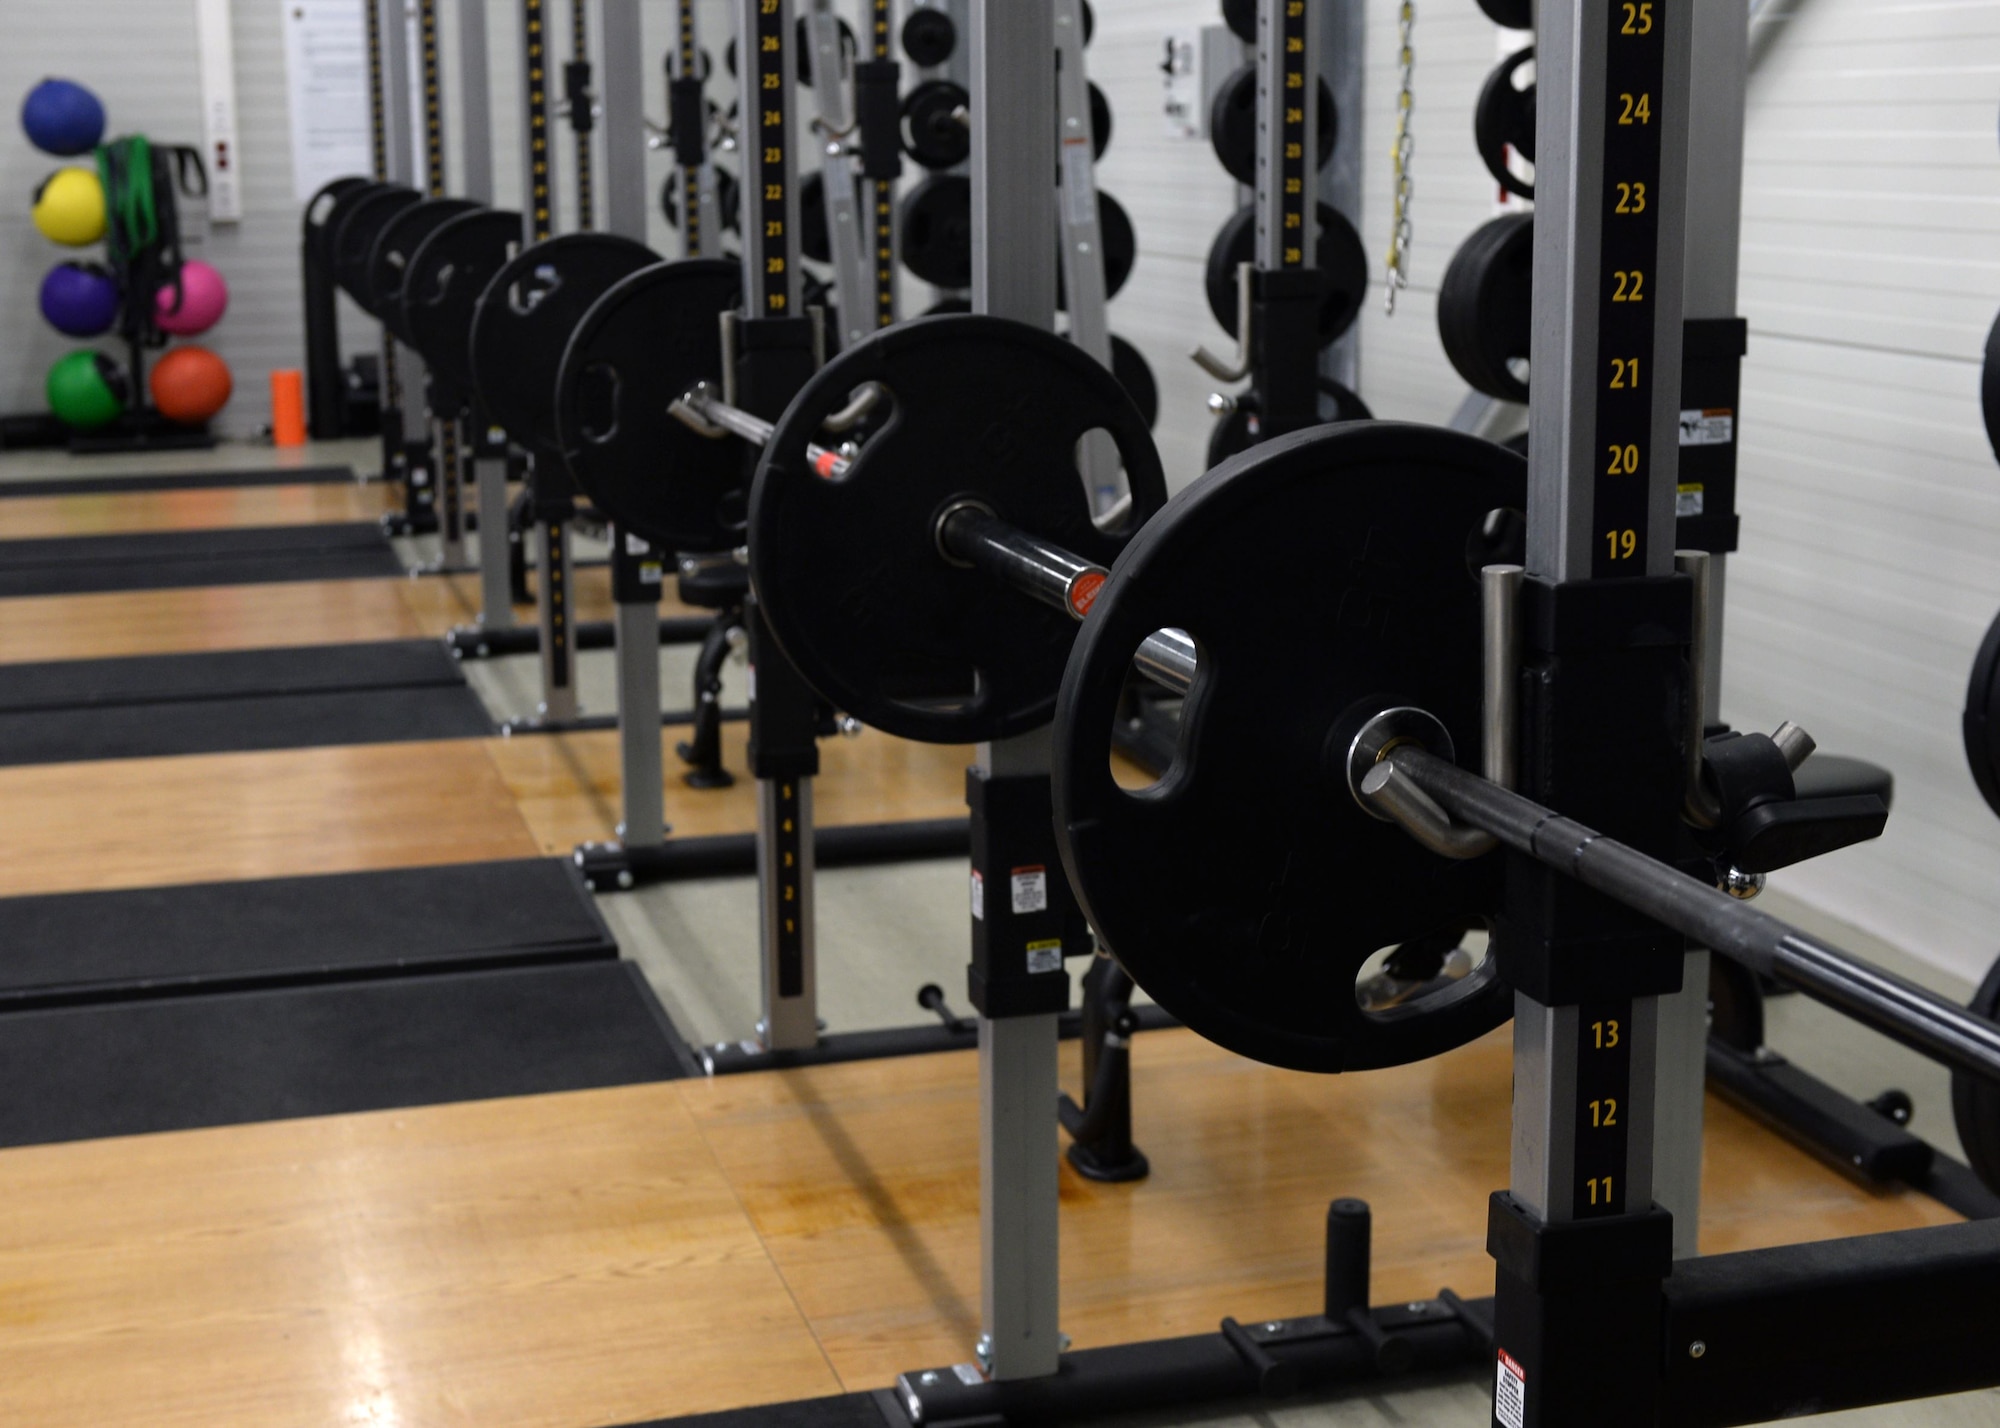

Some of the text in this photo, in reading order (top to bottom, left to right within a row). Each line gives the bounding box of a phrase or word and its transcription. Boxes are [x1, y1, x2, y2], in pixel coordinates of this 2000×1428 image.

[1620, 2, 1653, 35] 25
[762, 36, 780, 53] 26
[763, 73, 780, 90] 25
[764, 111, 781, 127] 24
[1618, 93, 1651, 125] 24
[765, 148, 781, 164] 23
[766, 185, 782, 201] 22
[1615, 182, 1646, 214] 23
[767, 221, 782, 238] 21
[767, 258, 784, 274] 20
[1612, 270, 1643, 302] 22
[769, 294, 785, 309] 19
[1609, 358, 1639, 389] 21
[1607, 444, 1639, 475] 20
[1606, 529, 1636, 560] 19
[1592, 1020, 1619, 1049] 13
[1589, 1098, 1617, 1127] 12
[1587, 1176, 1612, 1205] 11
[1505, 1354, 1524, 1380] DANGER
